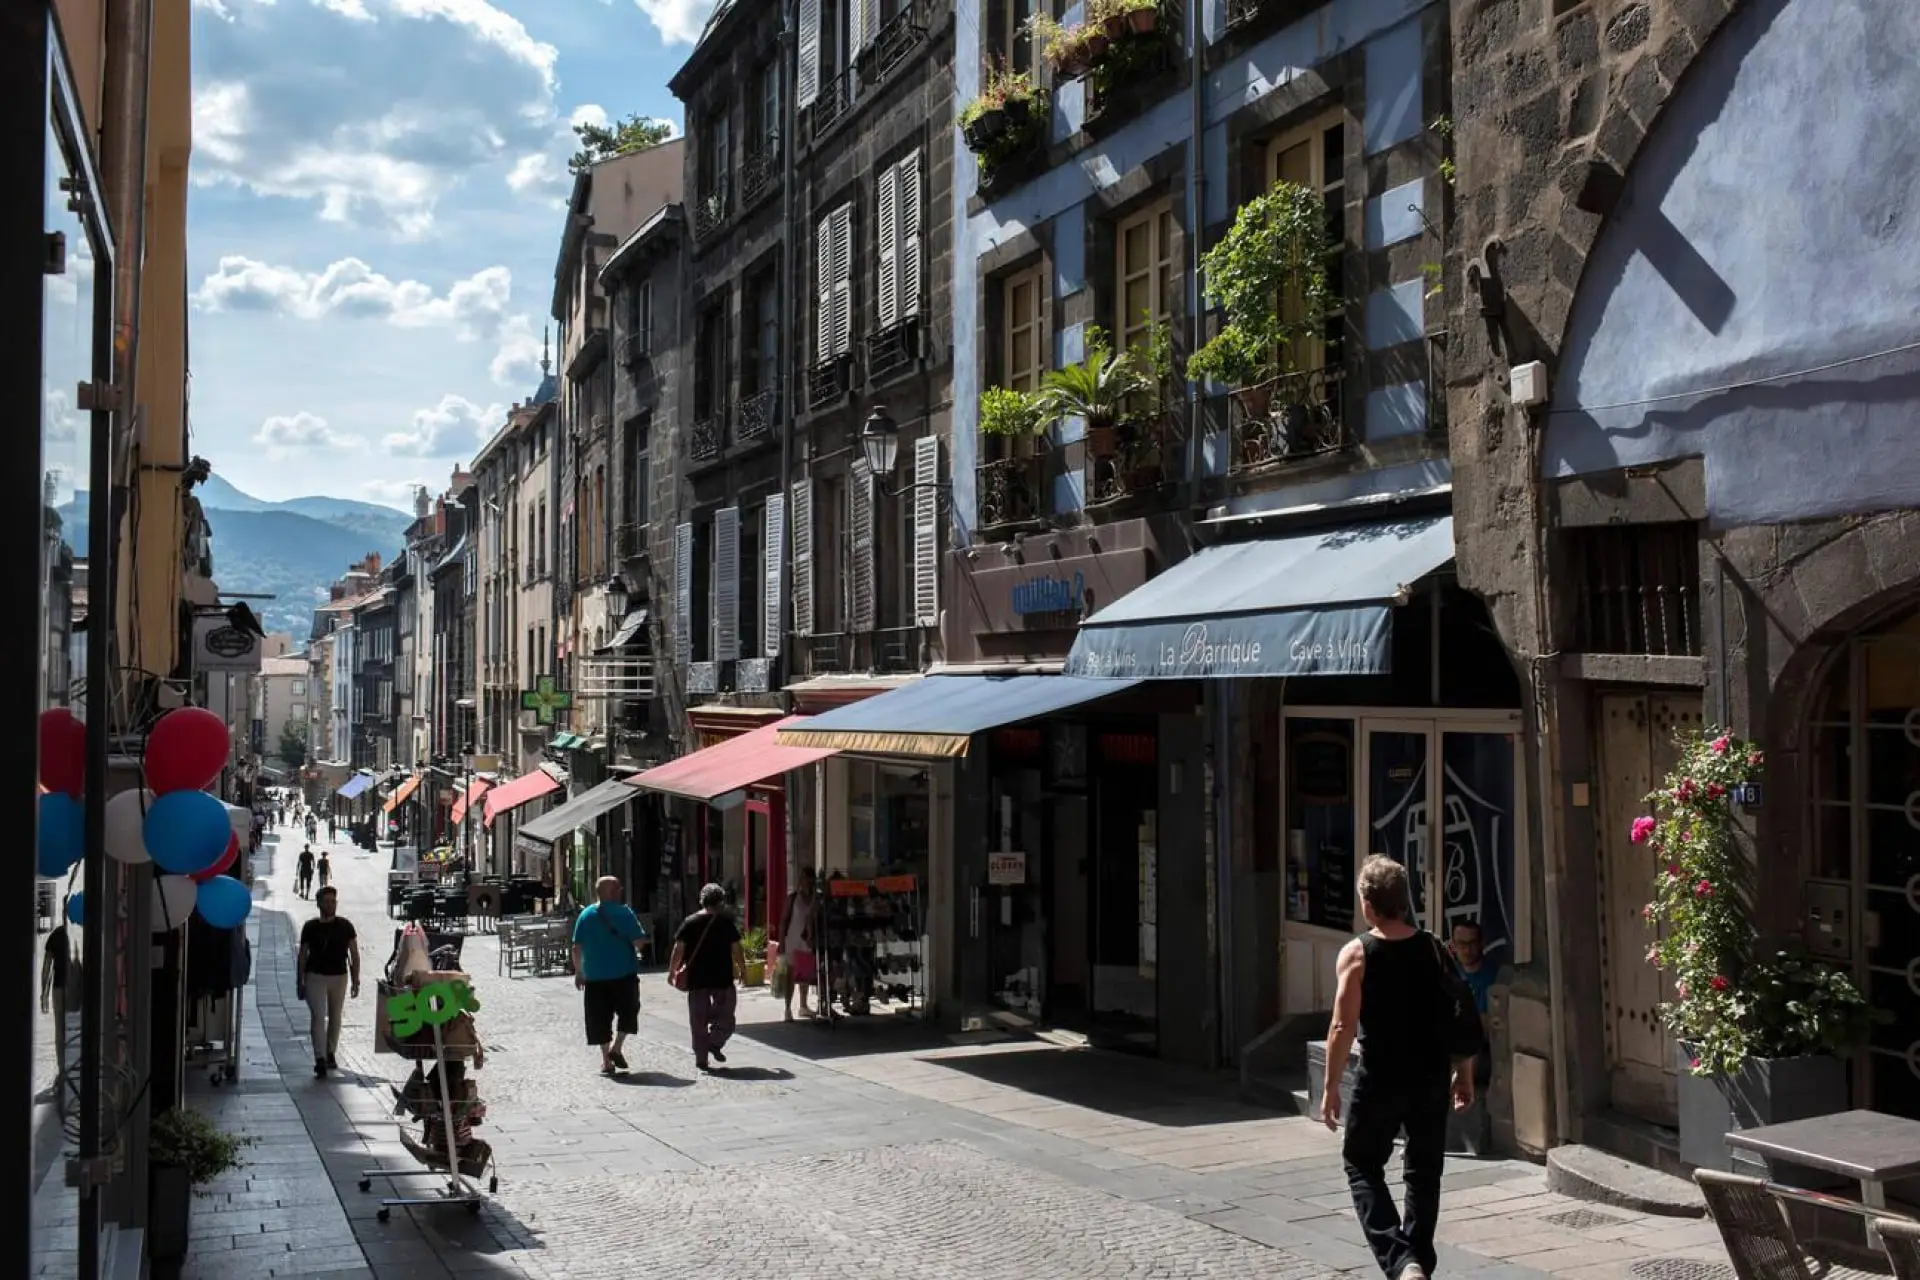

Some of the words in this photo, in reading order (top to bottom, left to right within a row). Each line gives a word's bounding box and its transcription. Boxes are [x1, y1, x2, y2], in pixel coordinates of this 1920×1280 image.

[1160, 641, 1174, 665] La
[1181, 622, 1261, 668] Barrique
[1289, 639, 1322, 660] Cave
[1339, 635, 1368, 660] Vins
